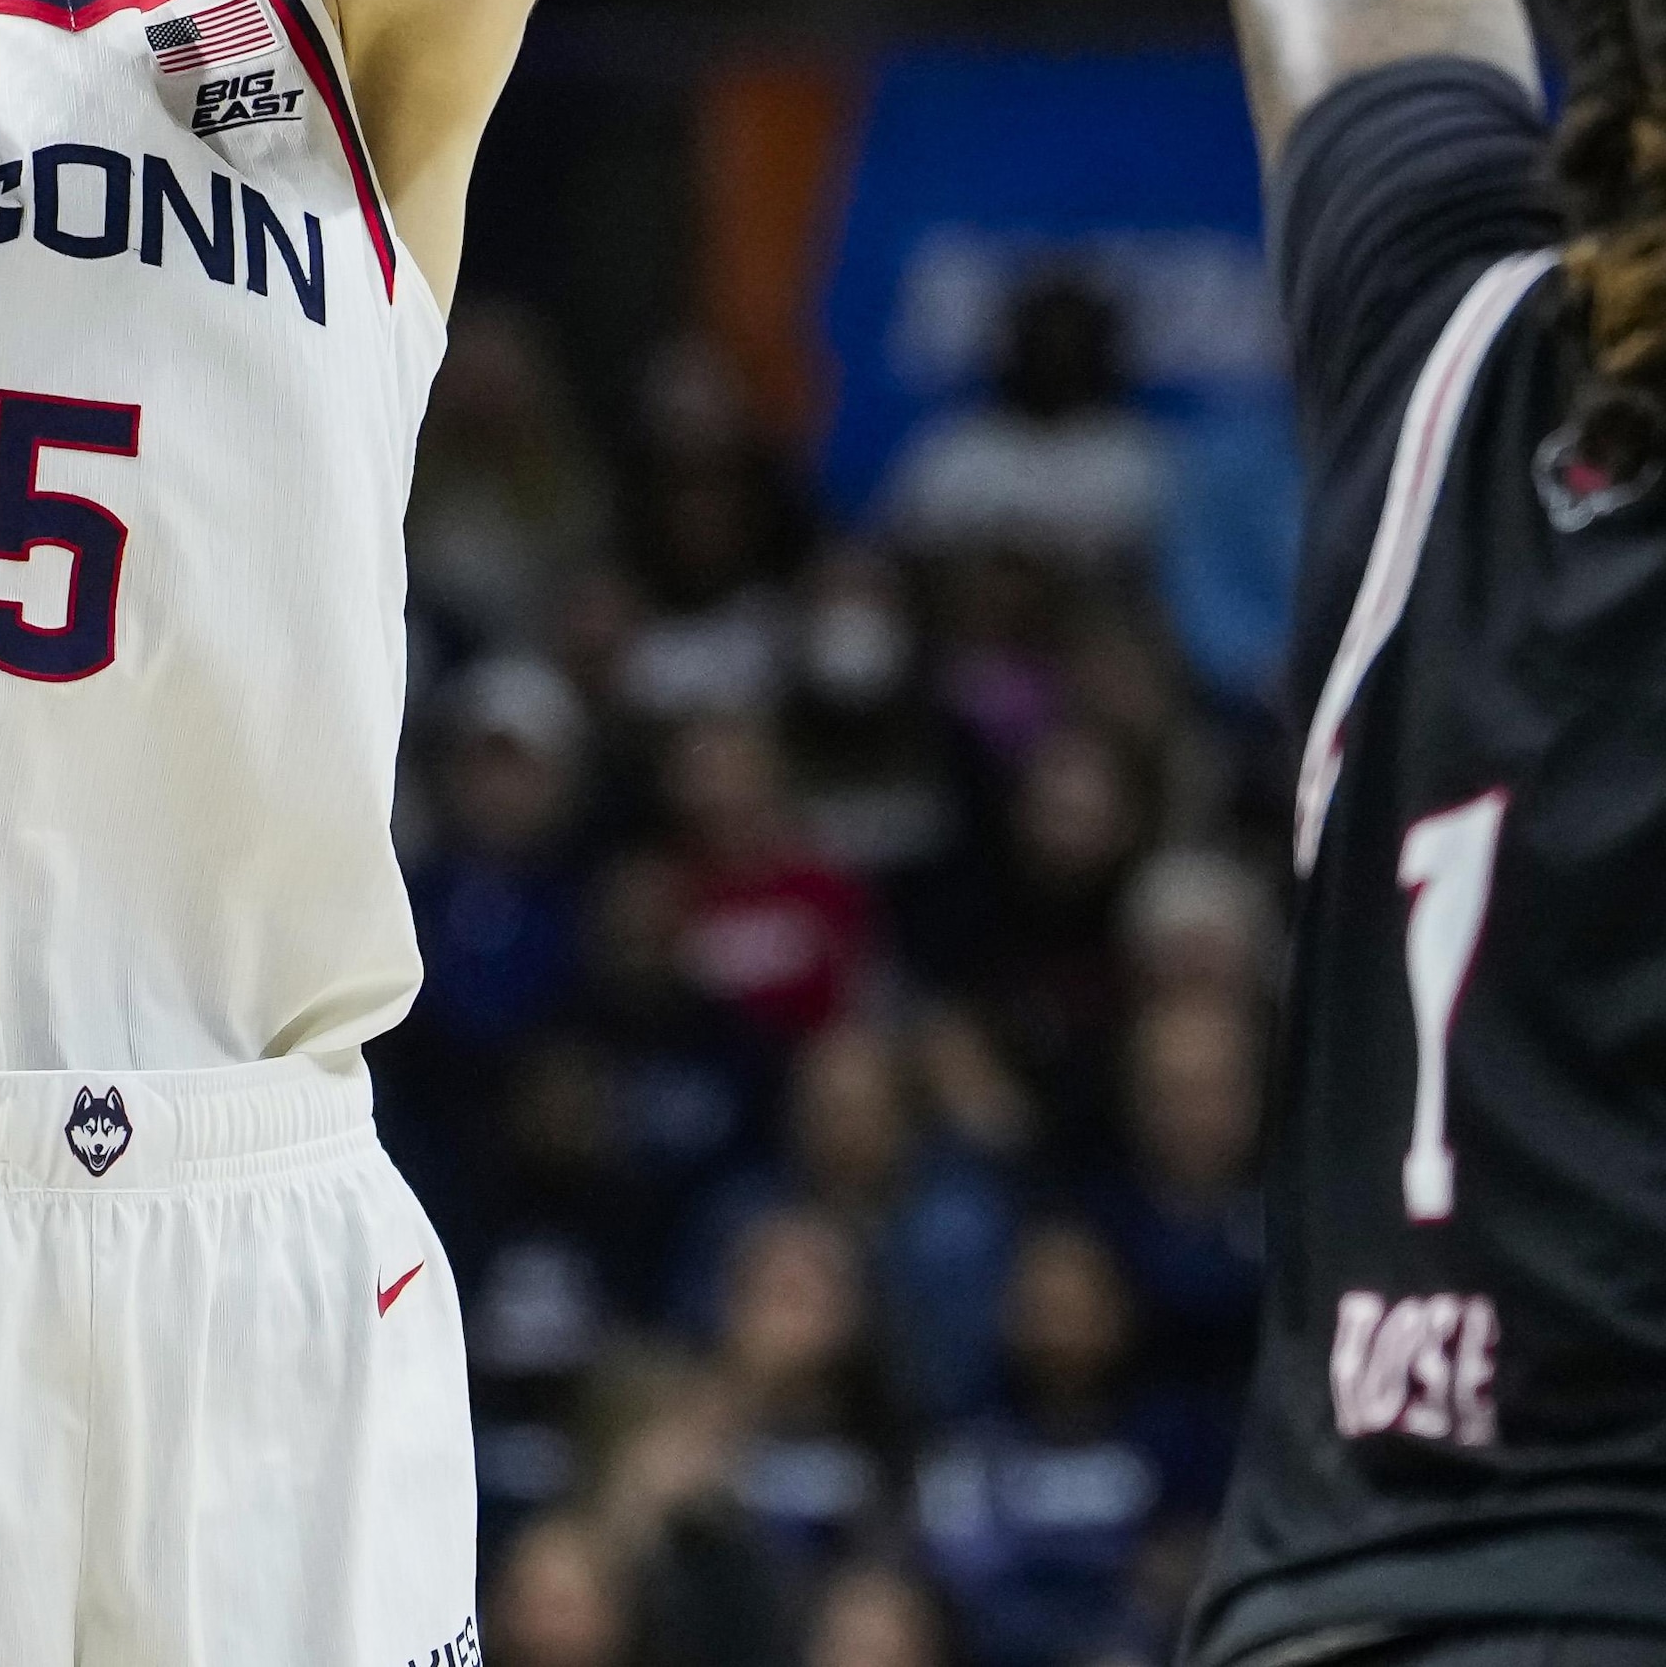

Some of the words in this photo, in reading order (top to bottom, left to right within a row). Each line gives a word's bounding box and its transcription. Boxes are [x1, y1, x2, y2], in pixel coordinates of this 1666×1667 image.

[196, 69, 275, 106] BIG
[192, 89, 305, 129] EAST
[1395, 786, 1511, 1226] 1
